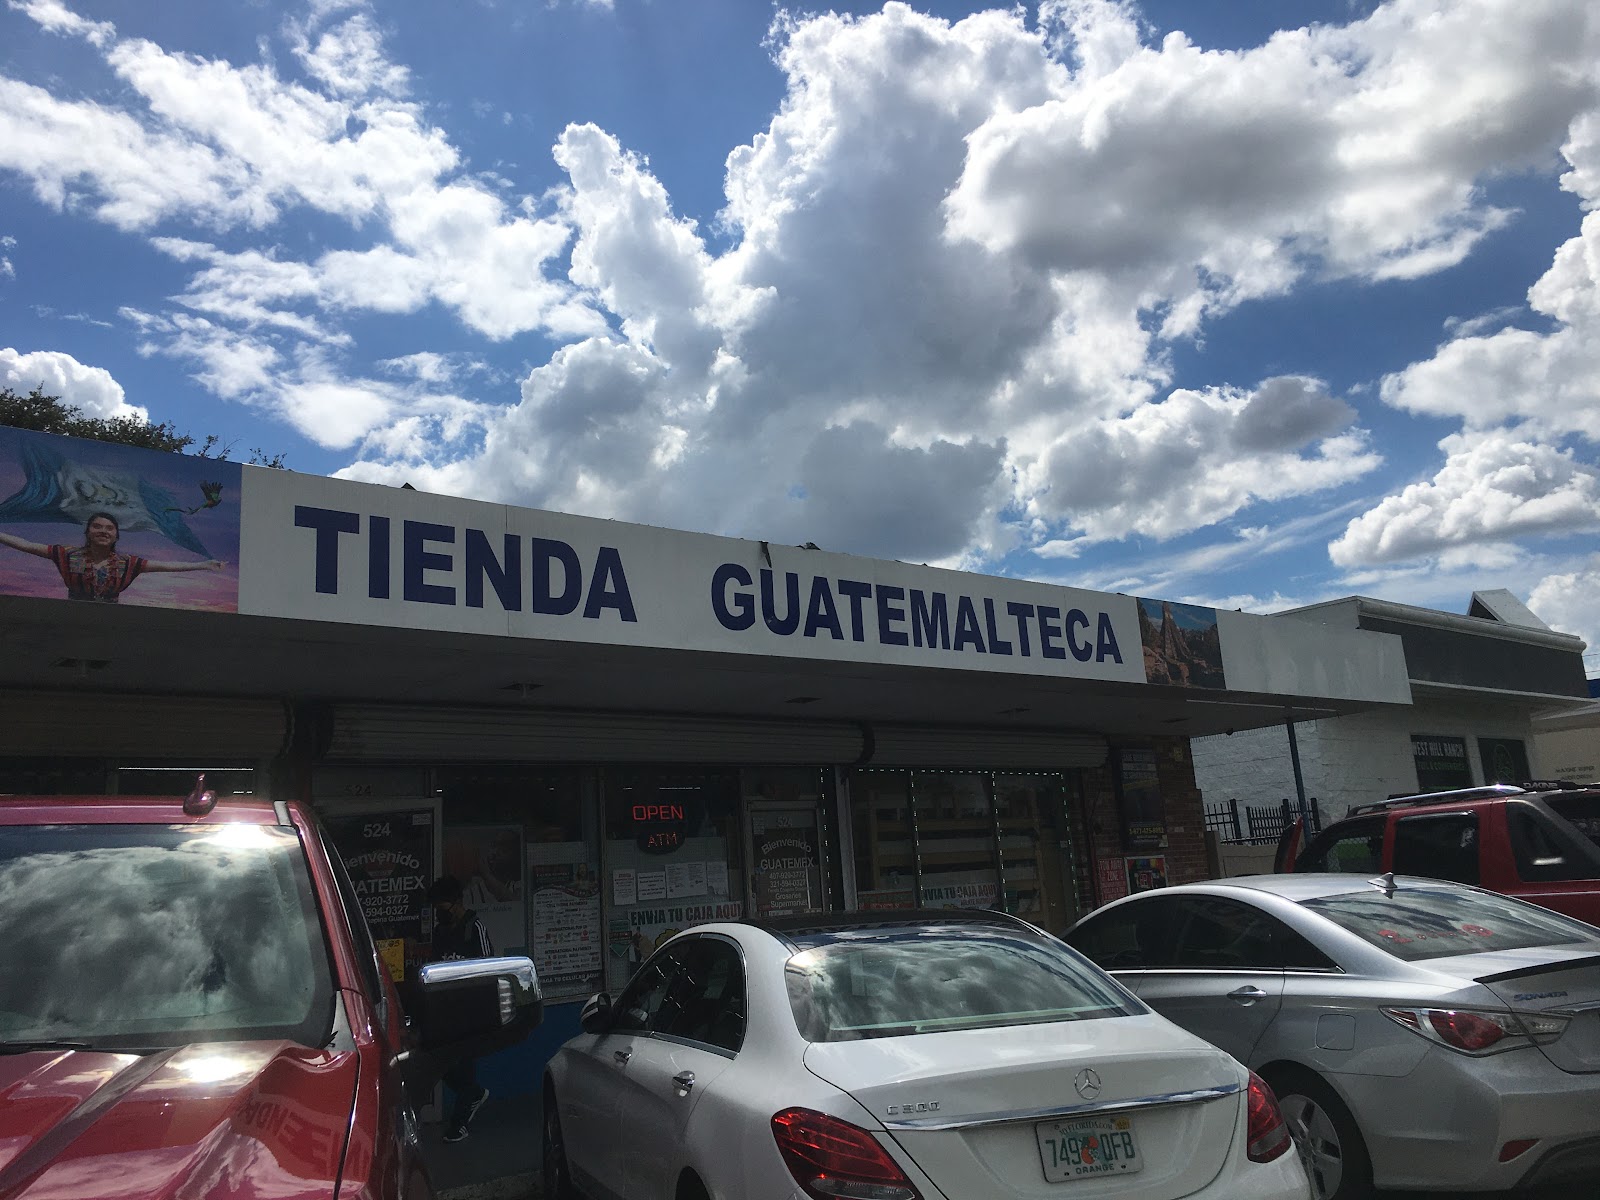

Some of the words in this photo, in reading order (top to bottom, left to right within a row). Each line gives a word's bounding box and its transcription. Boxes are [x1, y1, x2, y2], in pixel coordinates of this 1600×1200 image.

[294, 505, 638, 622] TIENDA
[711, 563, 1123, 665] GUATEMALTECA
[632, 805, 684, 821] OPEN
[363, 822, 391, 838] 524
[647, 832, 678, 848] ATM
[761, 838, 812, 855] Bienvenido
[344, 850, 420, 871] ienvenido
[351, 875, 425, 894] ATEMEX
[359, 894, 409, 906] 7-920-3772
[925, 888, 943, 901] NVIA
[365, 905, 409, 917] 594-0327
[630, 908, 665, 927] ENVIA
[667, 907, 683, 923] TU
[685, 905, 713, 921] CAJA
[716, 903, 741, 920] AQUI
[1513, 991, 1568, 1002] SONATA
[887, 1105, 898, 1115] C
[902, 1100, 941, 1114] 300
[1045, 1137, 1082, 1168] 749
[1075, 1163, 1115, 1175] ORANGE
